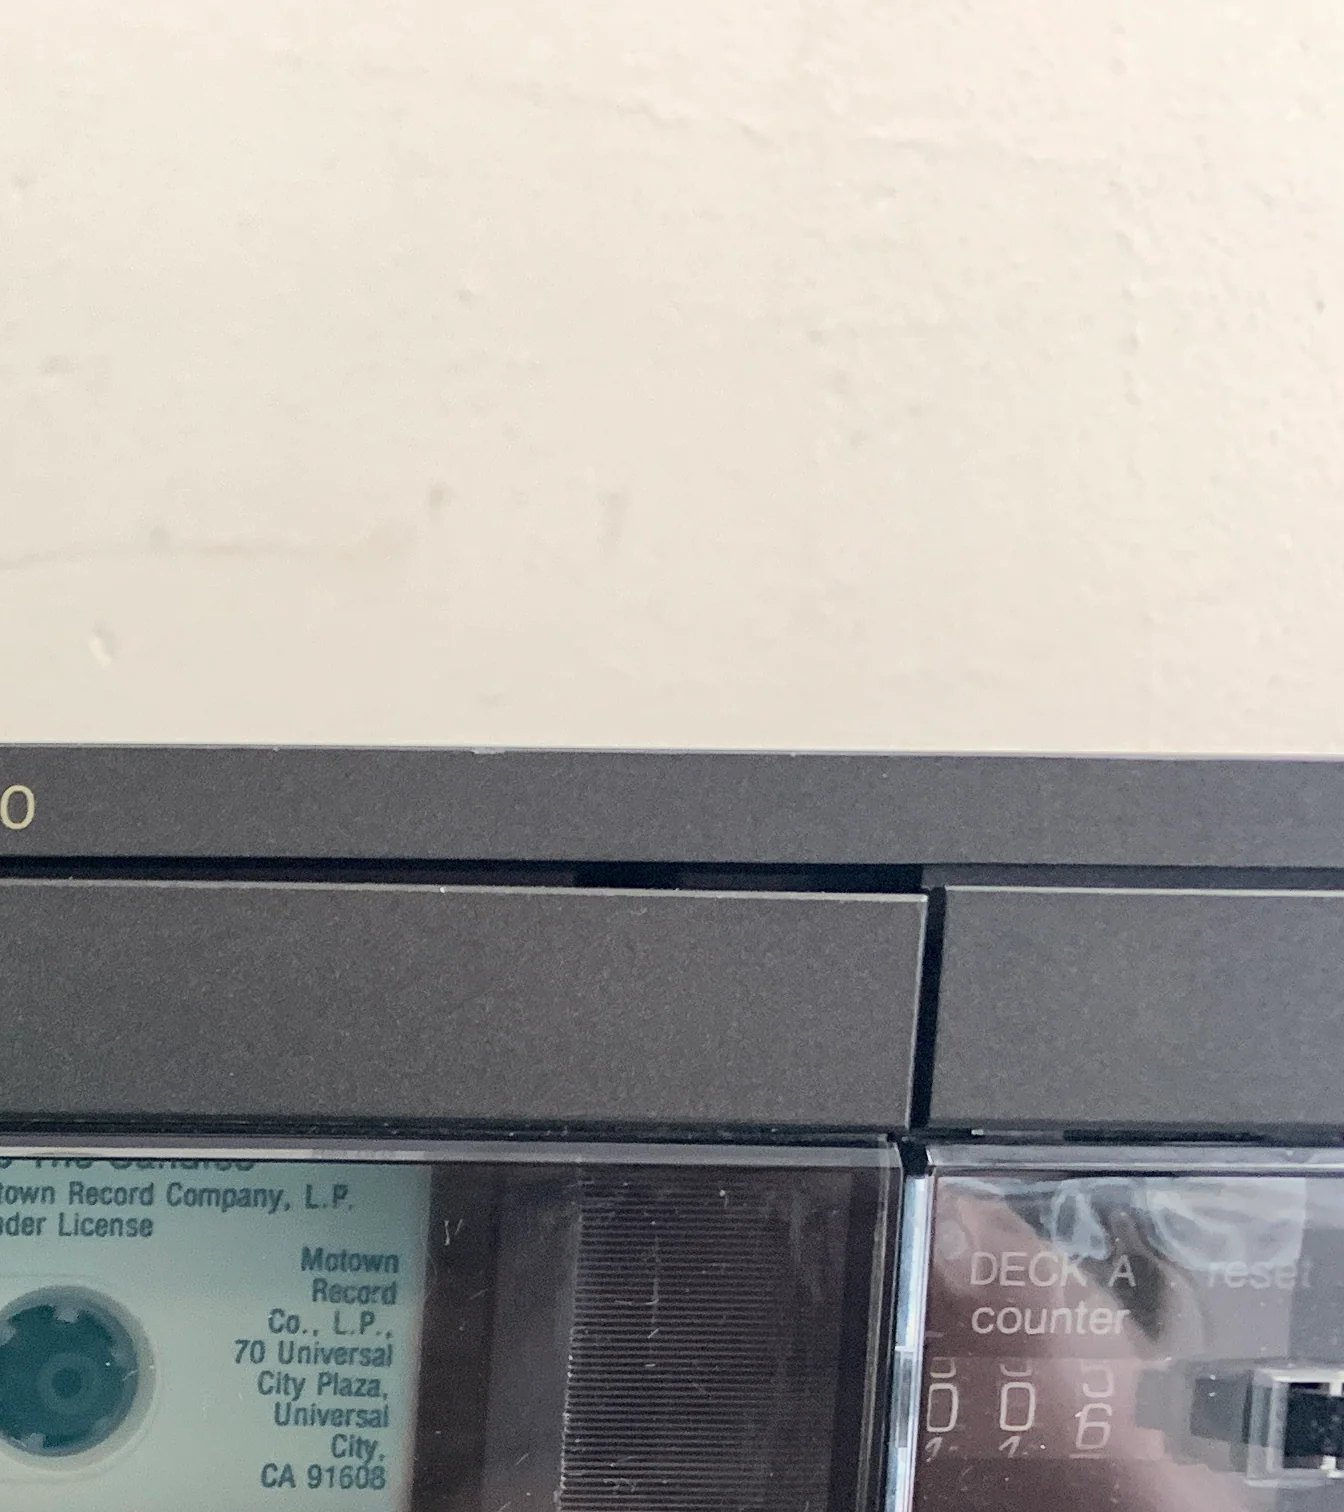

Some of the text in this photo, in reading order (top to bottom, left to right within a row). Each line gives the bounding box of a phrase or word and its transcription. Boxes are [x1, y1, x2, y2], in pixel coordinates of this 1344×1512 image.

[69, 1181, 154, 1206] Record
[167, 1182, 291, 1214] Company,
[305, 1184, 352, 1209] L.P.
[58, 1212, 154, 1237] License
[300, 1246, 400, 1274] Motown
[969, 1250, 1312, 1290] DECK A reset
[311, 1278, 398, 1305] Record
[268, 1308, 392, 1339] Co., L.P.,
[970, 1299, 1130, 1335] counter
[235, 1339, 393, 1367] 70 Universal
[258, 1370, 387, 1402] City Plaza,
[274, 1402, 389, 1428] Universal
[330, 1432, 387, 1466] City,
[261, 1463, 388, 1490] CA 91608
